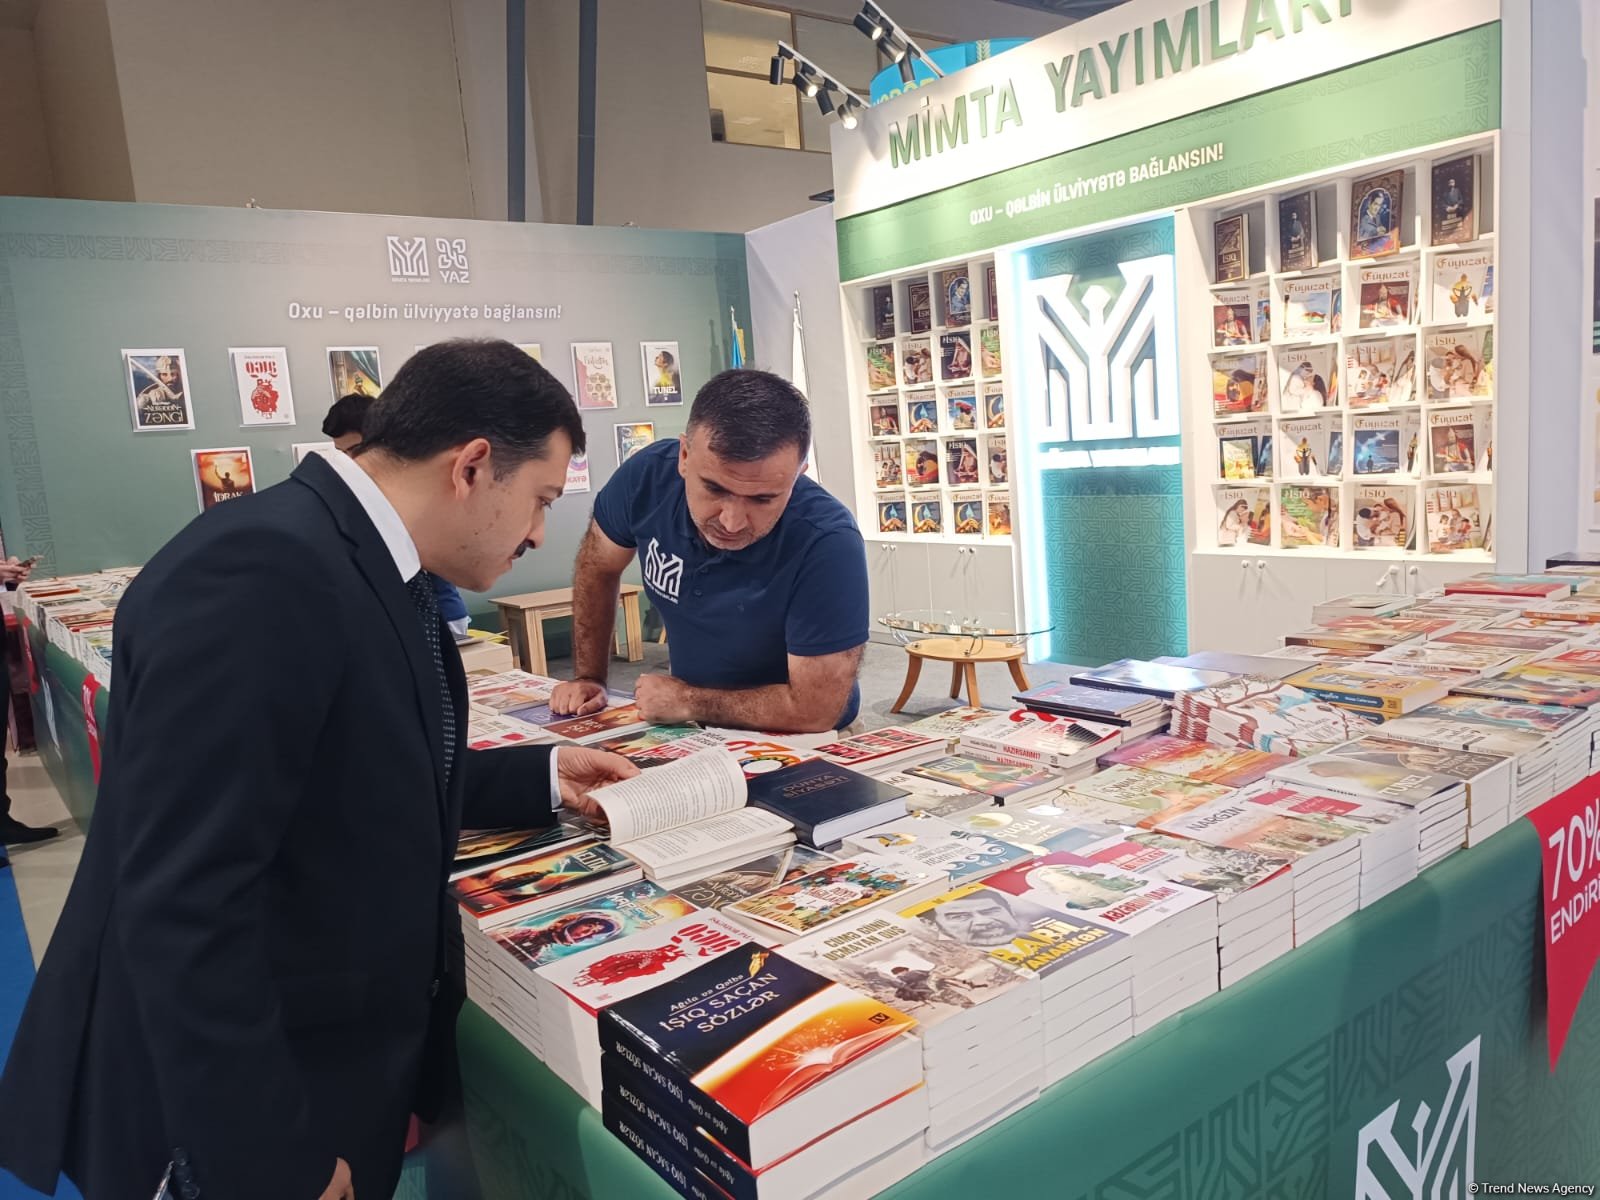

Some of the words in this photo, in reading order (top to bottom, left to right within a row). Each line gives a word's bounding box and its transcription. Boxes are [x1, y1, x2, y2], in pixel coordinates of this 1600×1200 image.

[888, 78, 1023, 168] MİMTA
[970, 206, 993, 225] OXU
[1005, 188, 1051, 219] QƏLBİN
[1053, 170, 1125, 203] ÜLVİYYƏTƏ
[1129, 142, 1224, 184] BAĞLANSIN!
[440, 271, 470, 284] YAZ
[289, 303, 322, 319] Oxu
[344, 304, 398, 322] qəlbin
[404, 303, 478, 322] ülviyyətə
[484, 303, 562, 322] bağlansın!
[1549, 798, 1600, 901] 70%
[697, 990, 781, 1033] SÖZLƏR
[709, 973, 779, 1009] SAÇAN
